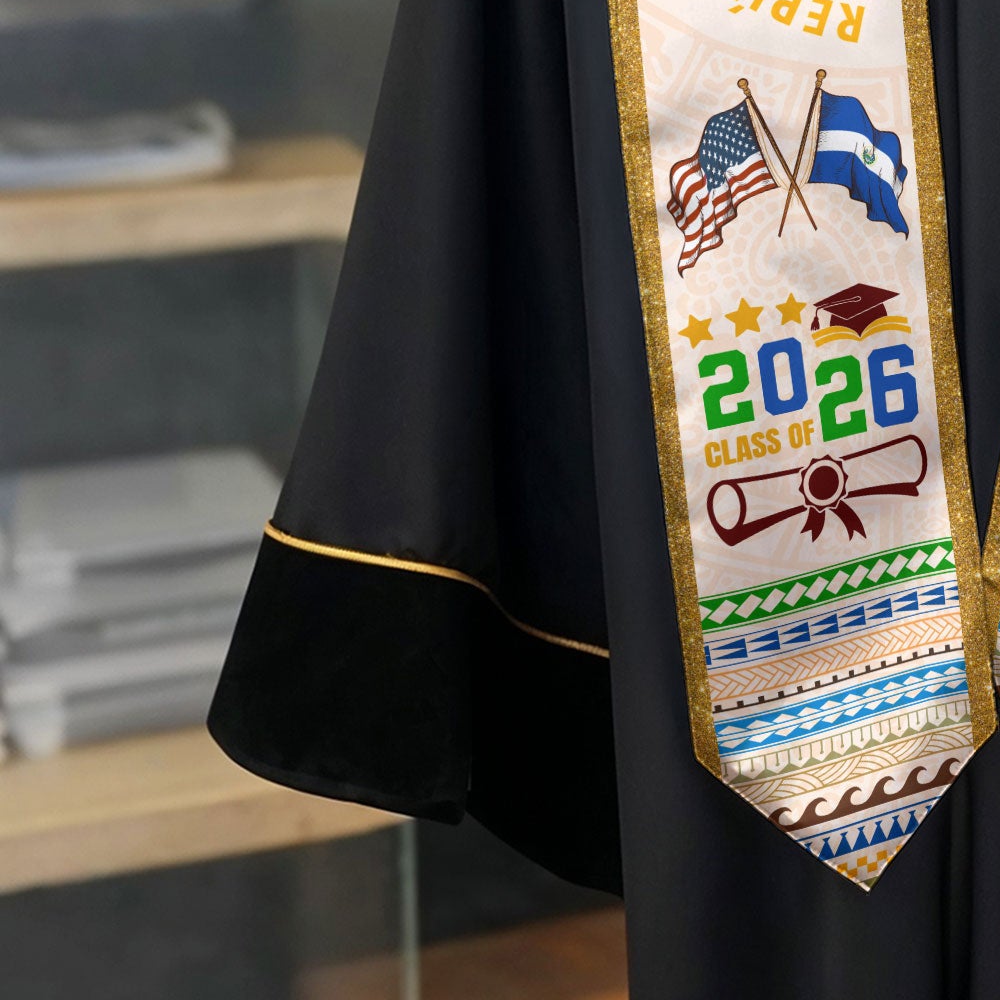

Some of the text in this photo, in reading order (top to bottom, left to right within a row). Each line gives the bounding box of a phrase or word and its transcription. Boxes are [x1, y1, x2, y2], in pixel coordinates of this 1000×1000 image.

[698, 337, 919, 442] 2026
[704, 419, 815, 468] CLASS OF
